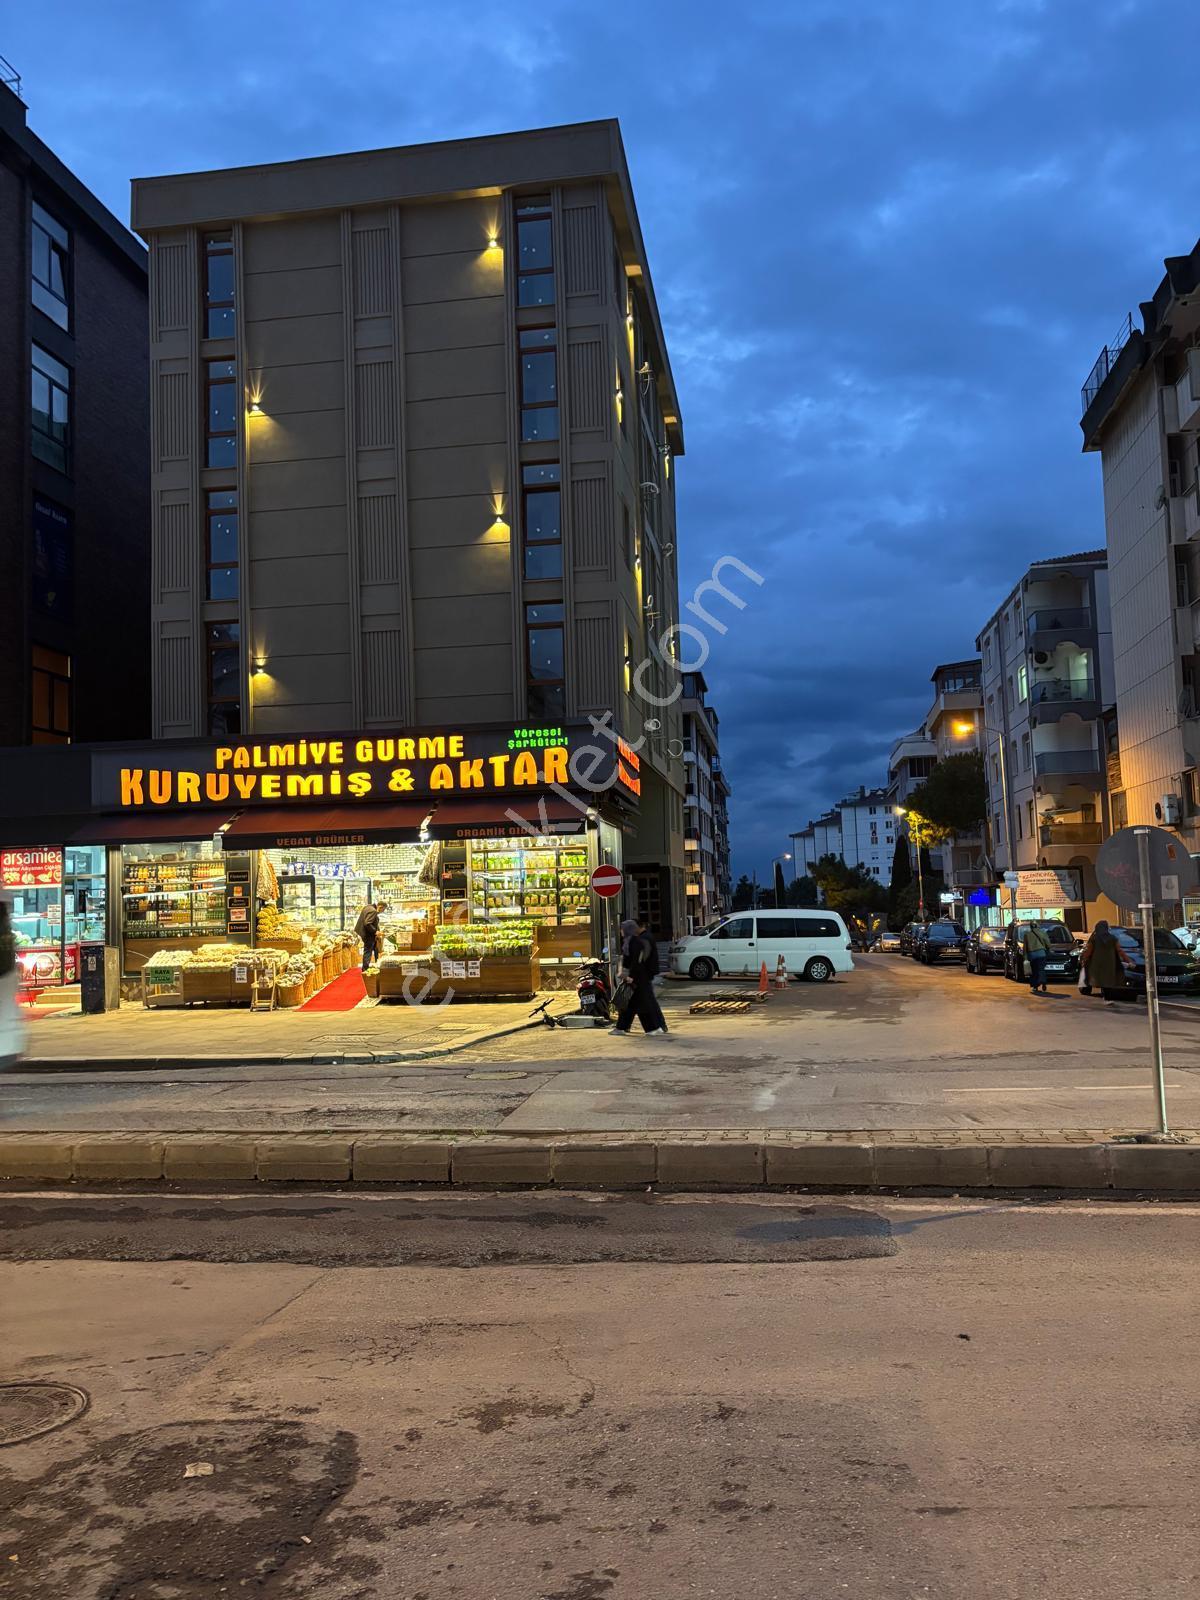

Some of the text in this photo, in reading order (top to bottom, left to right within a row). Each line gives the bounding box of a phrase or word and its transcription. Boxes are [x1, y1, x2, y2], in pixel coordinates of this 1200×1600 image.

[507, 737, 569, 750] Şarküteri
[514, 727, 562, 739] Yöresel
[215, 735, 464, 769] PALMİYE GURME
[120, 747, 569, 805] KURUYEMİŞ & AKTAR
